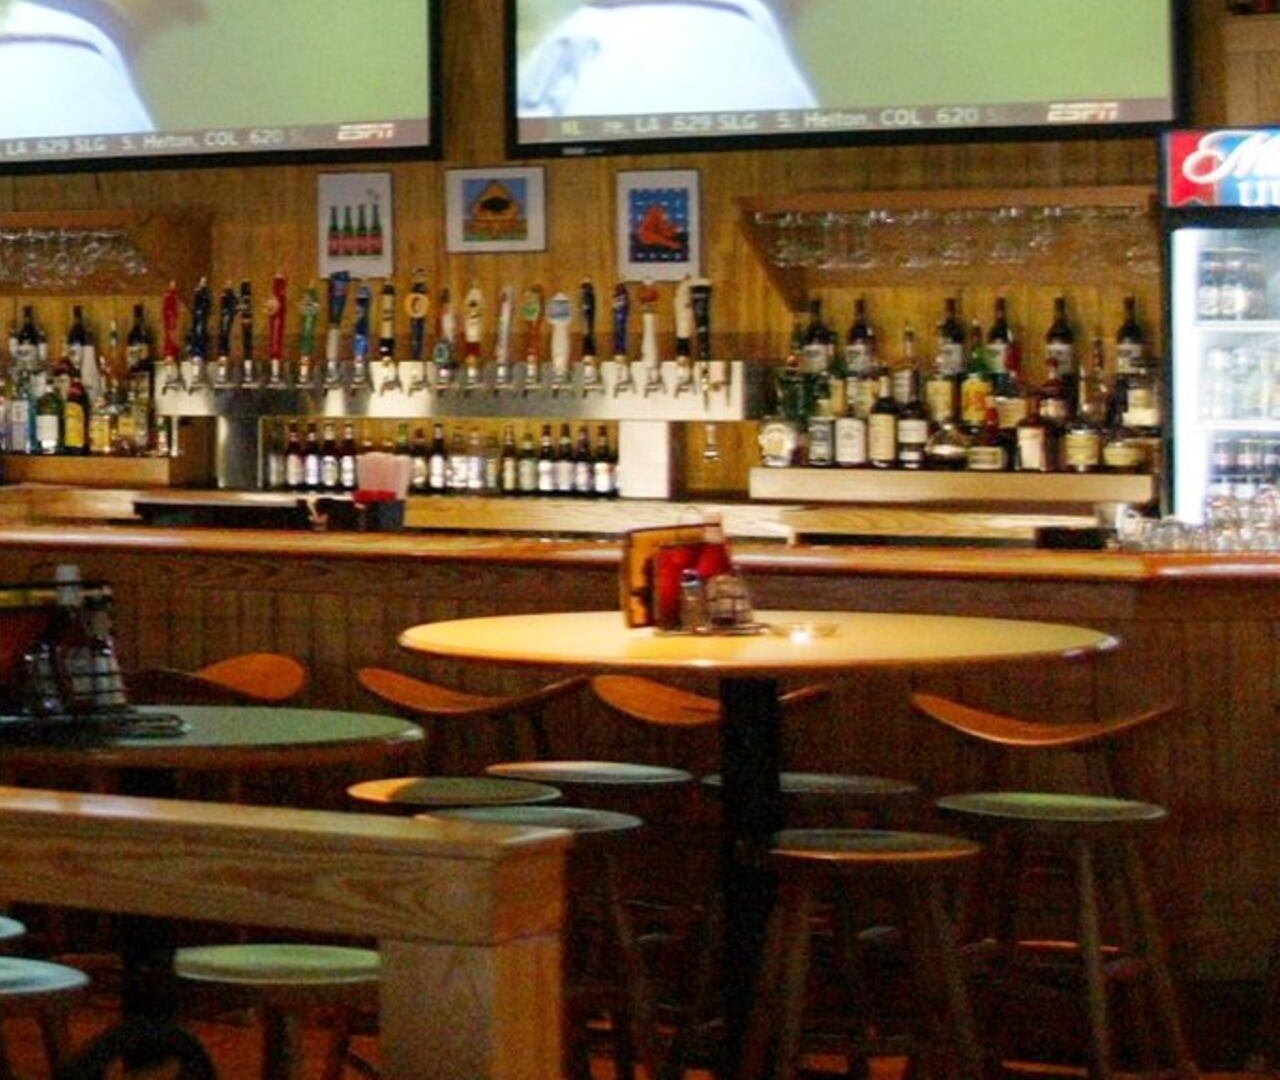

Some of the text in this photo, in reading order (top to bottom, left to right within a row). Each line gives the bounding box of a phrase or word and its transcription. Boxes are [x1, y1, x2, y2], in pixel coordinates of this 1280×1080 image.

[635, 115, 660, 133] LA
[717, 112, 759, 130] SLG
[880, 107, 920, 125] COL
[1046, 102, 1119, 122] ESPN
[73, 136, 107, 154] SLG
[204, 129, 238, 147] COL
[336, 123, 395, 141] ESPN
